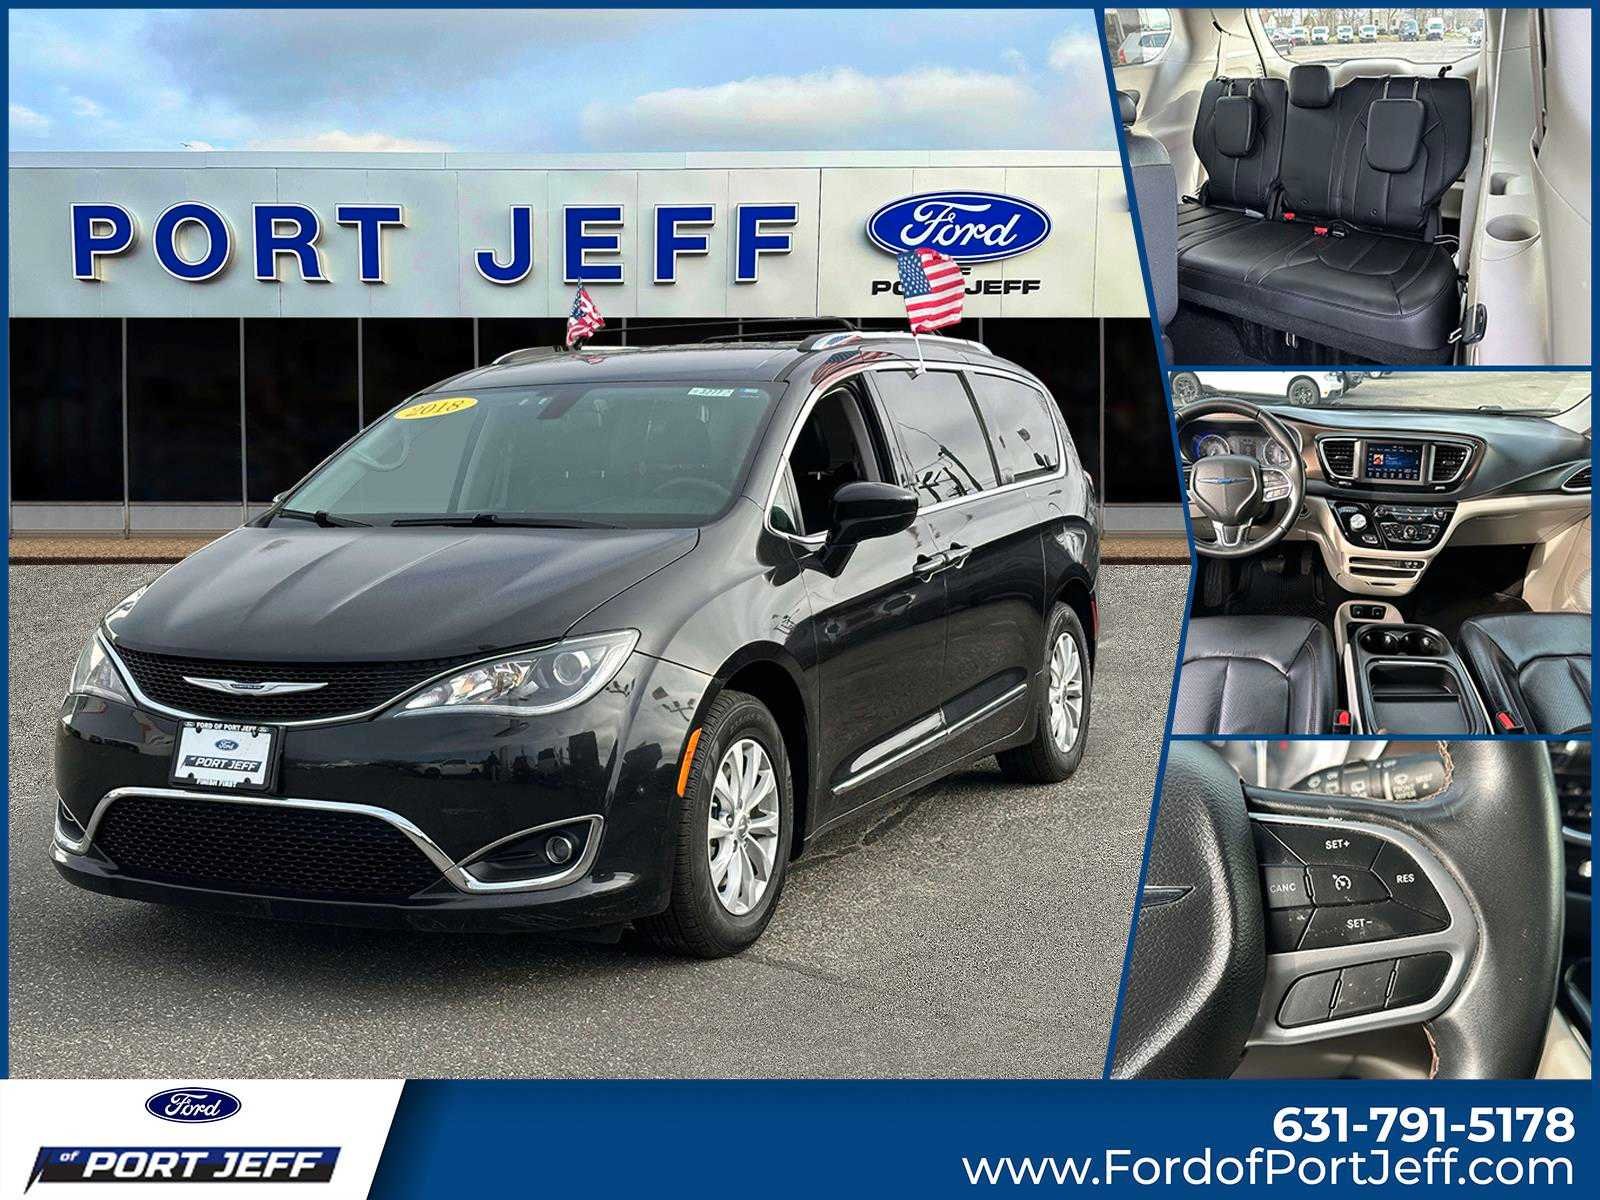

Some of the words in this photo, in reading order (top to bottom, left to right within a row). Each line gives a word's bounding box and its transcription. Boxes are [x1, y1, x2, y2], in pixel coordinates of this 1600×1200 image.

[900, 201, 1021, 246] Ford
[70, 202, 406, 284] PORT
[473, 202, 801, 285] JEFF
[965, 279, 1041, 296] JEFF
[405, 400, 465, 417] 2018
[195, 757, 228, 769] PORT
[228, 761, 258, 771] JEFF
[1325, 838, 1351, 850] SET+
[1396, 873, 1415, 884] RES
[1269, 882, 1297, 893] CANC
